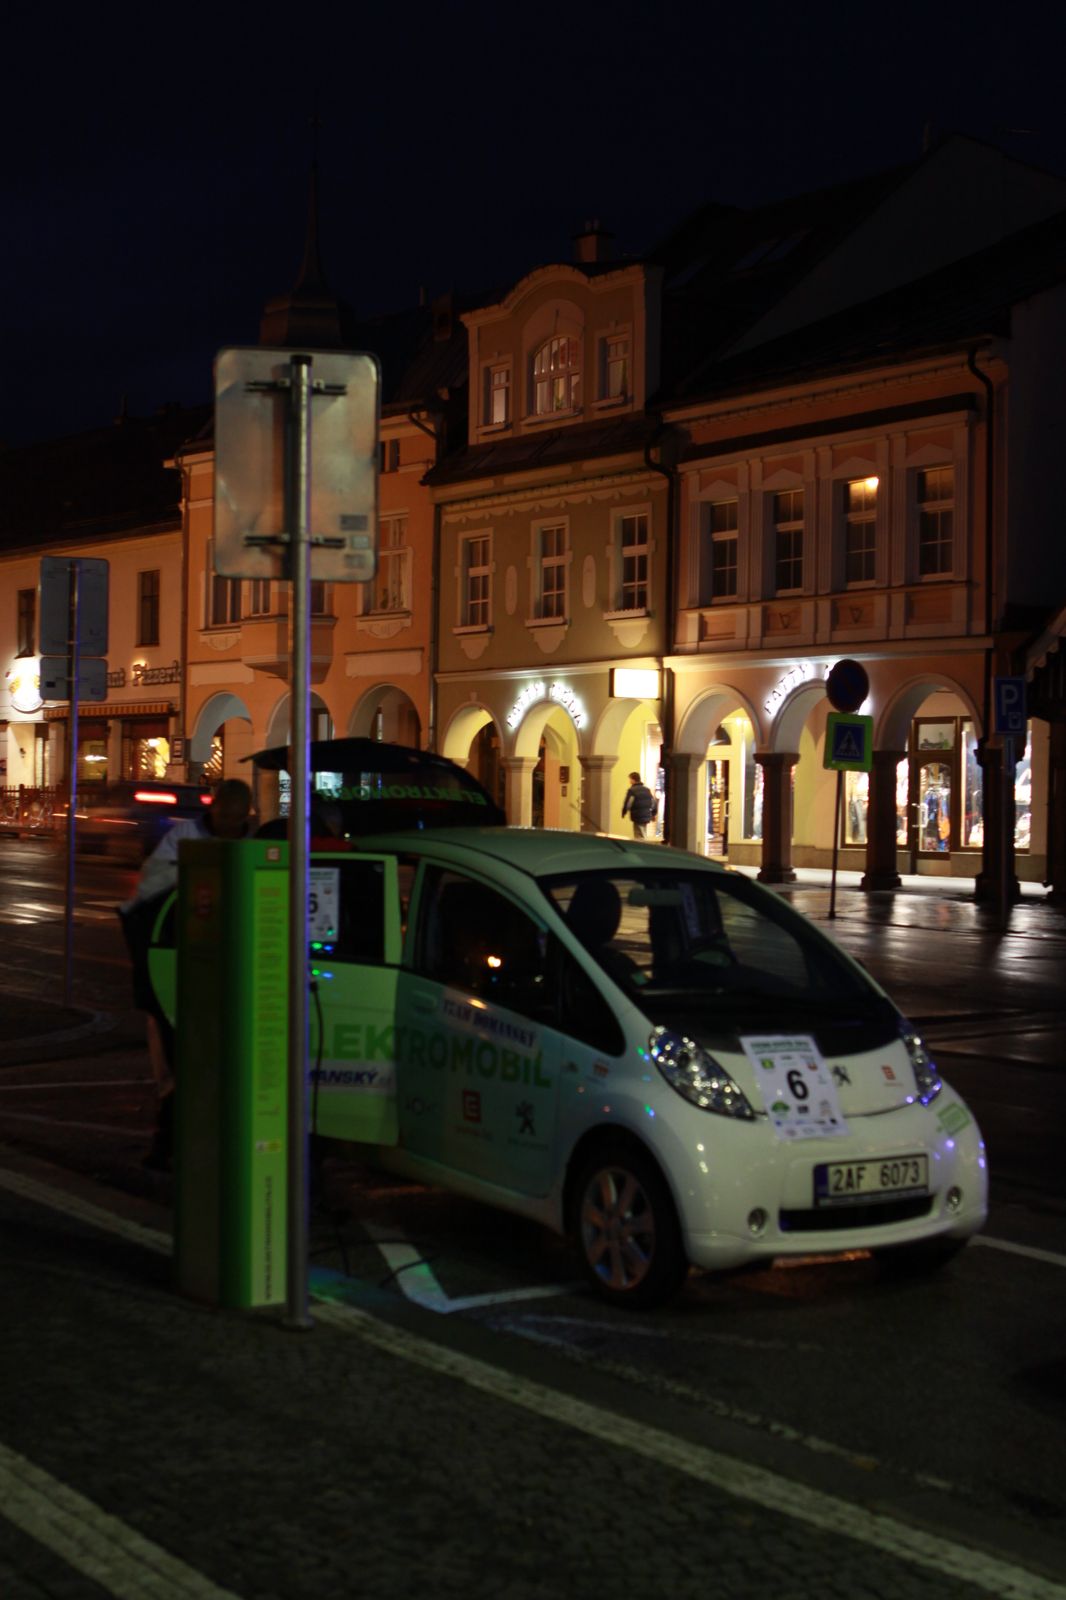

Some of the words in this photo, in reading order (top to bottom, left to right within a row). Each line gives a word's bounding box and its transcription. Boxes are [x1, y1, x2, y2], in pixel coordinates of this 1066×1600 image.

[1001, 684, 1019, 717] P
[309, 1023, 551, 1089] LEKTROMOBIL
[786, 1070, 809, 1100] 6
[833, 1166, 867, 1192] 2AF
[880, 1160, 920, 1187] 6073
